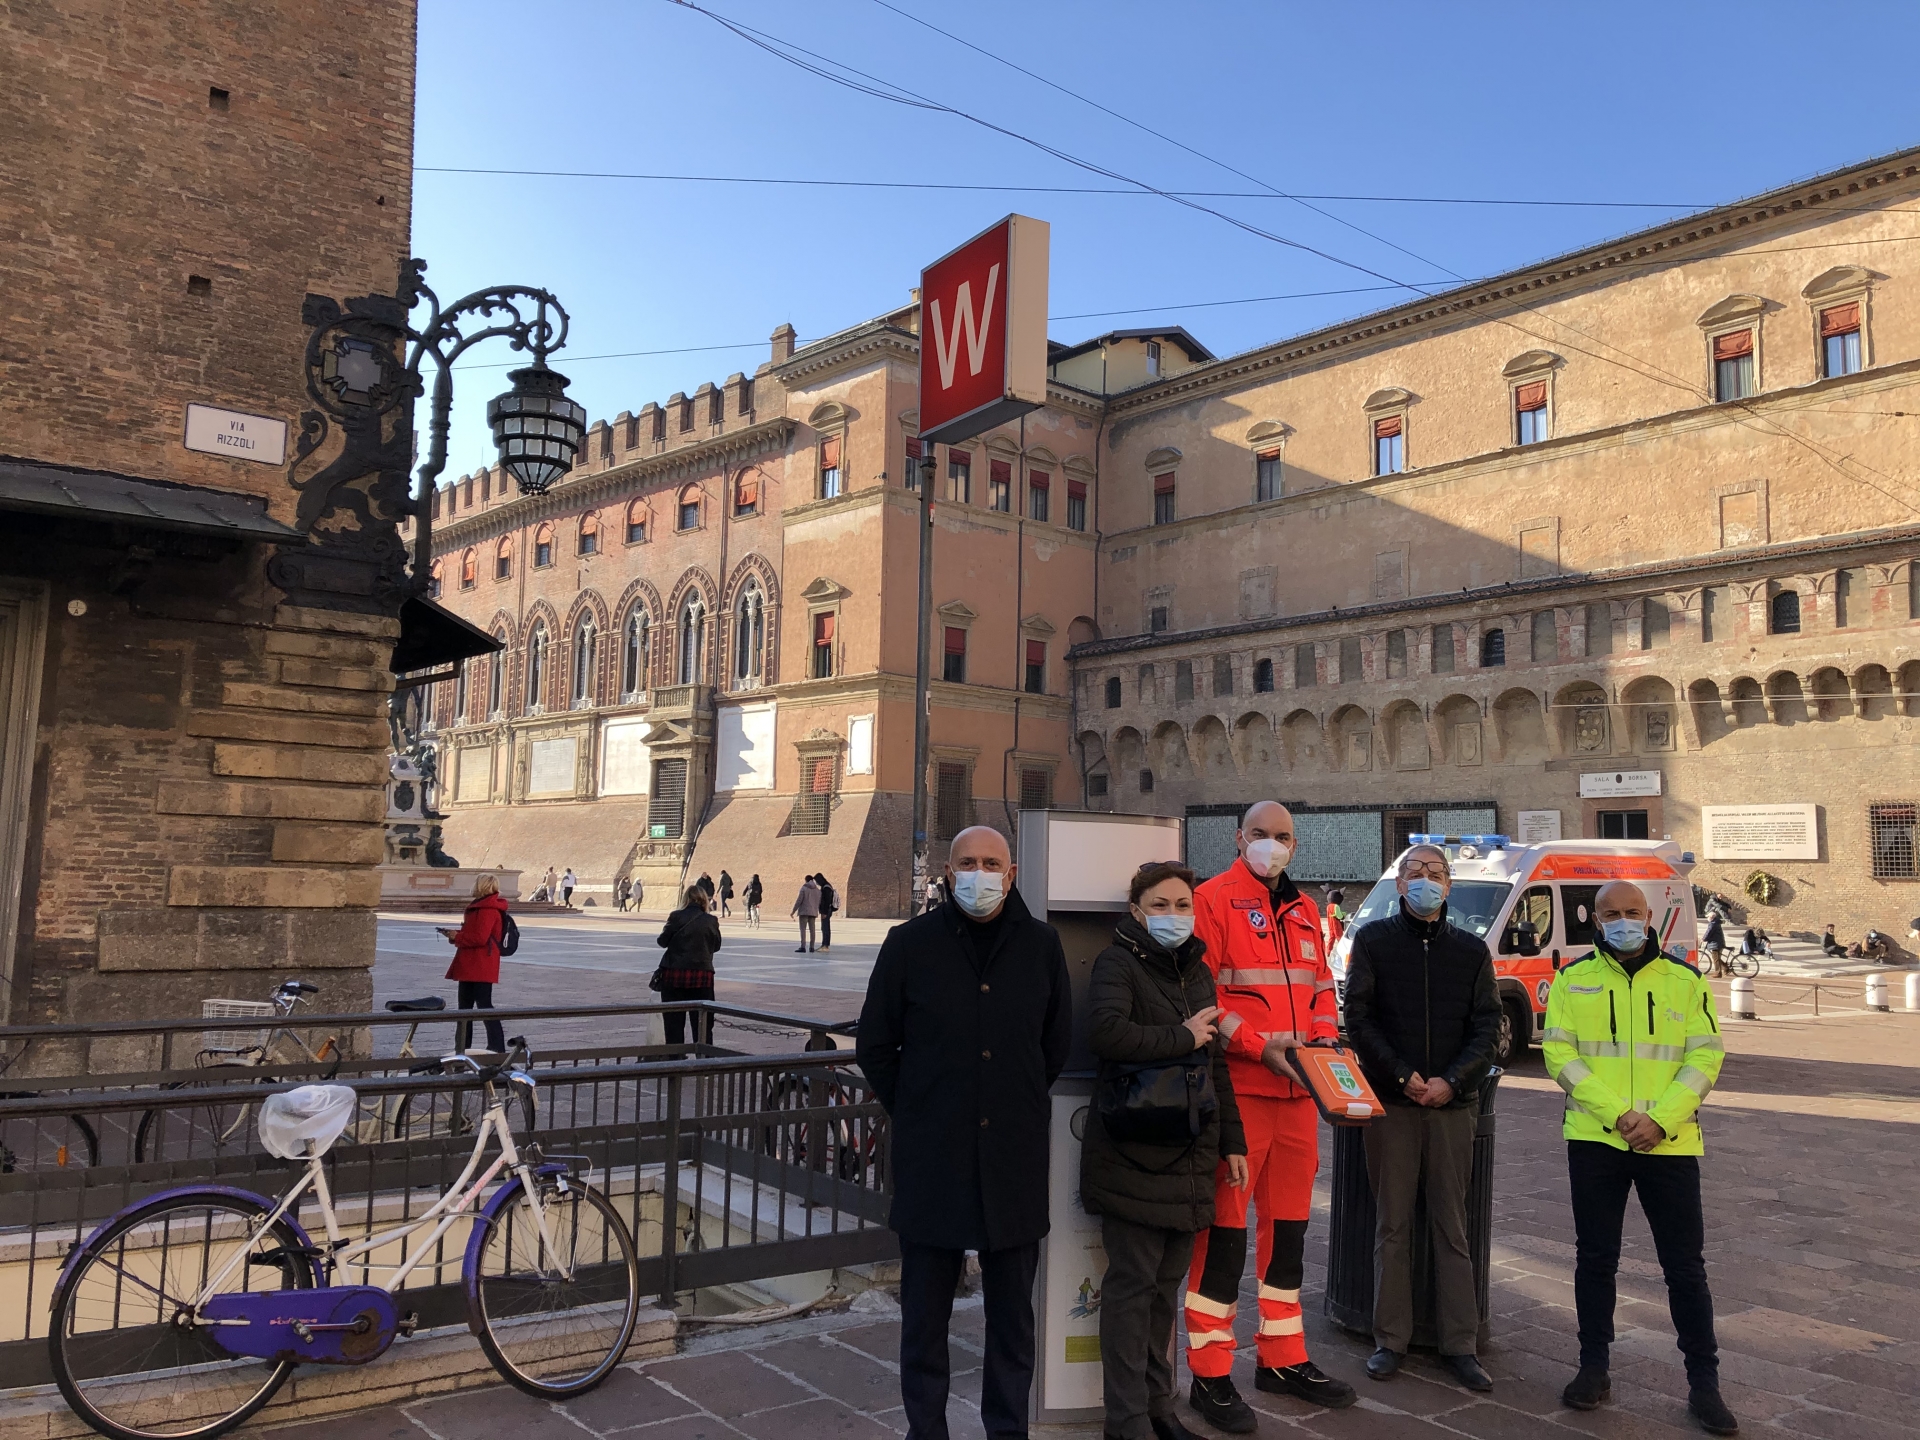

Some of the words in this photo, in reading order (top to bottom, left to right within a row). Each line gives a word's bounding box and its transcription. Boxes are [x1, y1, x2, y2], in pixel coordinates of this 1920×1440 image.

[930, 262, 1000, 390] W
[230, 421, 245, 432] VIA
[216, 433, 255, 450] RIZZOLI
[1334, 1069, 1351, 1077] AED
